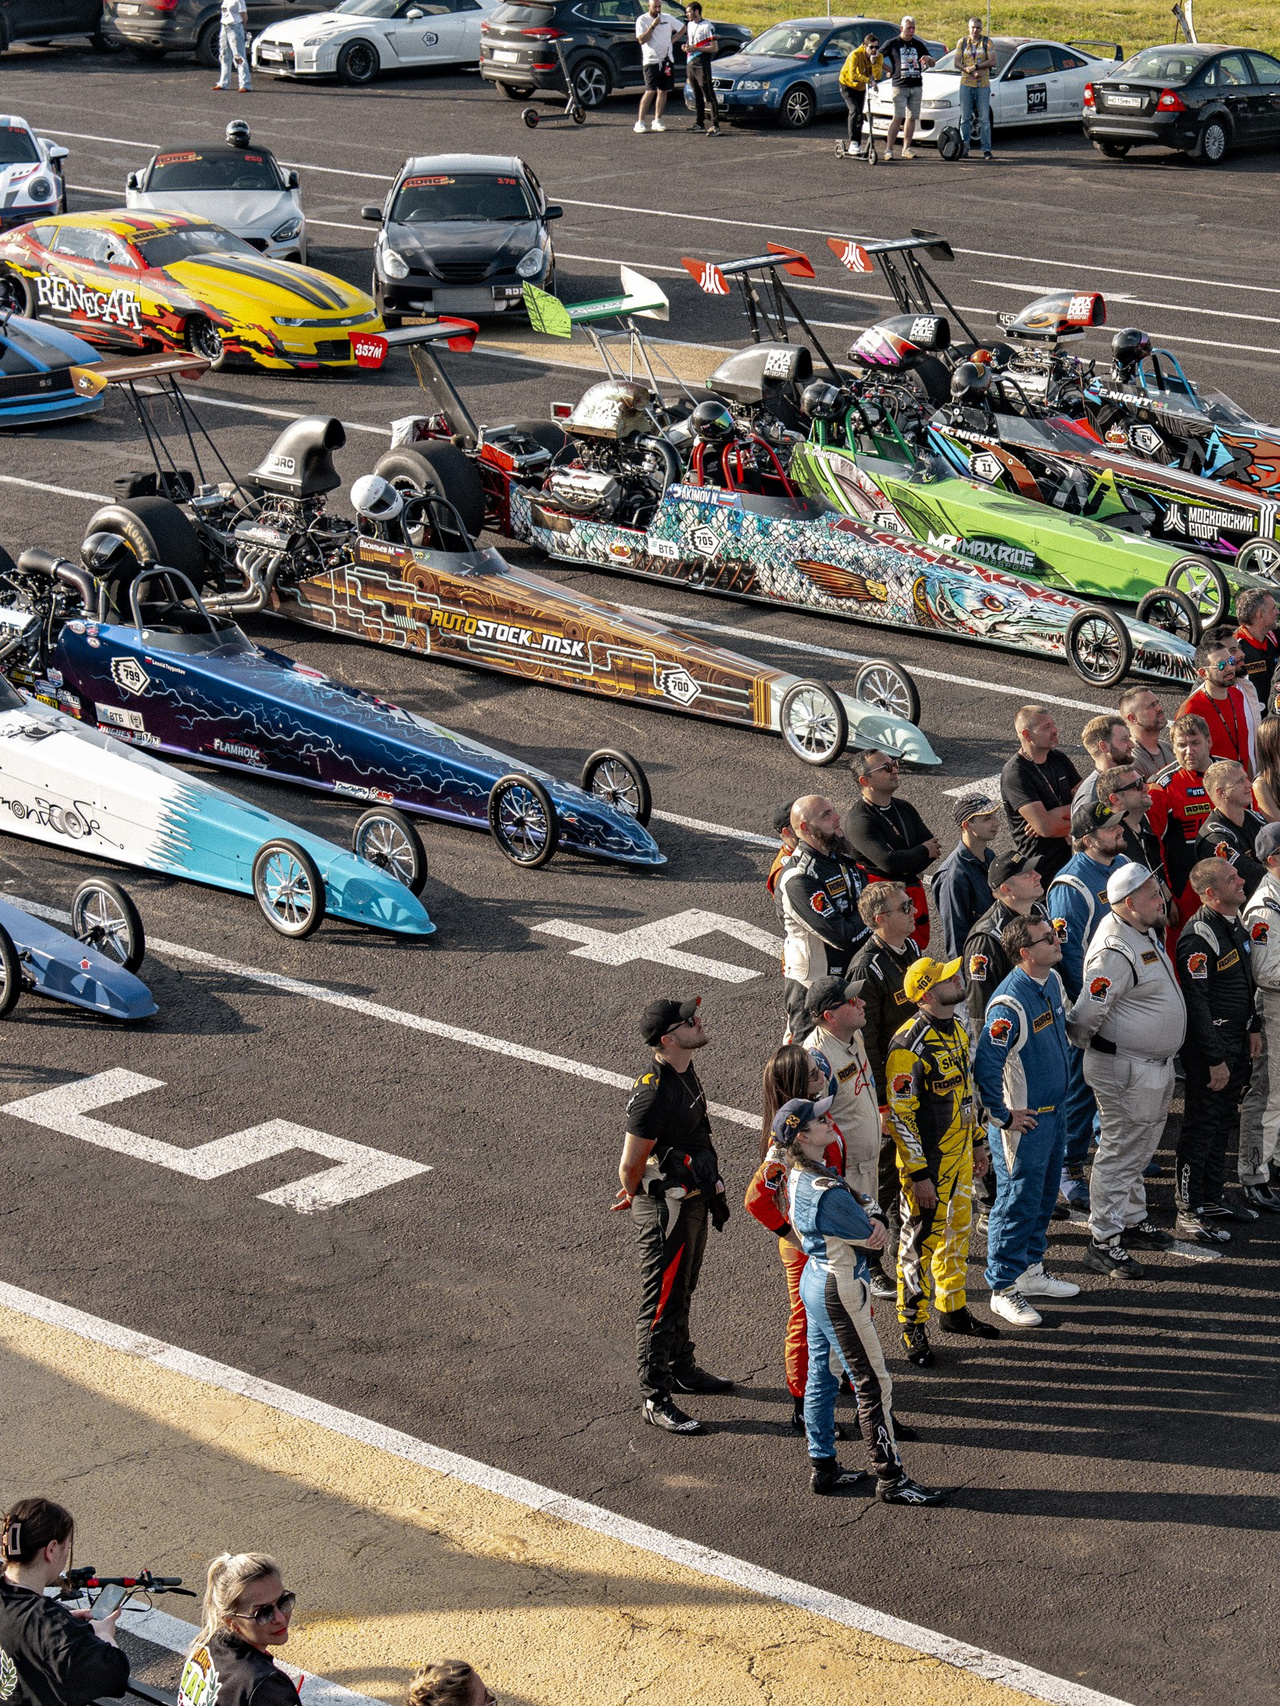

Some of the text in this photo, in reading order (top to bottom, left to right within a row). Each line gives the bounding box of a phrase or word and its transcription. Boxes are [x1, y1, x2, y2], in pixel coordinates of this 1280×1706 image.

[1028, 92, 1046, 104] 301
[914, 317, 939, 329] MAX
[909, 326, 935, 338] RIDE
[355, 348, 383, 364] 357M
[768, 349, 795, 362] MAX
[765, 359, 790, 372] RIDE
[763, 370, 789, 378] MOTORSPORT
[1141, 434, 1153, 444] 54
[981, 463, 993, 473] 11
[681, 488, 711, 503] AKIMOV
[1188, 505, 1254, 532] МОСКОВСКИЙ
[883, 520, 898, 533] 160
[1188, 524, 1220, 541] СПОРТ
[696, 535, 714, 547] 705
[430, 608, 586, 658] AUTOSTOCK_MSK
[122, 668, 141, 683] 799
[671, 679, 690, 694] 700
[213, 738, 261, 761] FLAMHOLC
[1185, 803, 1210, 814] RDRC
